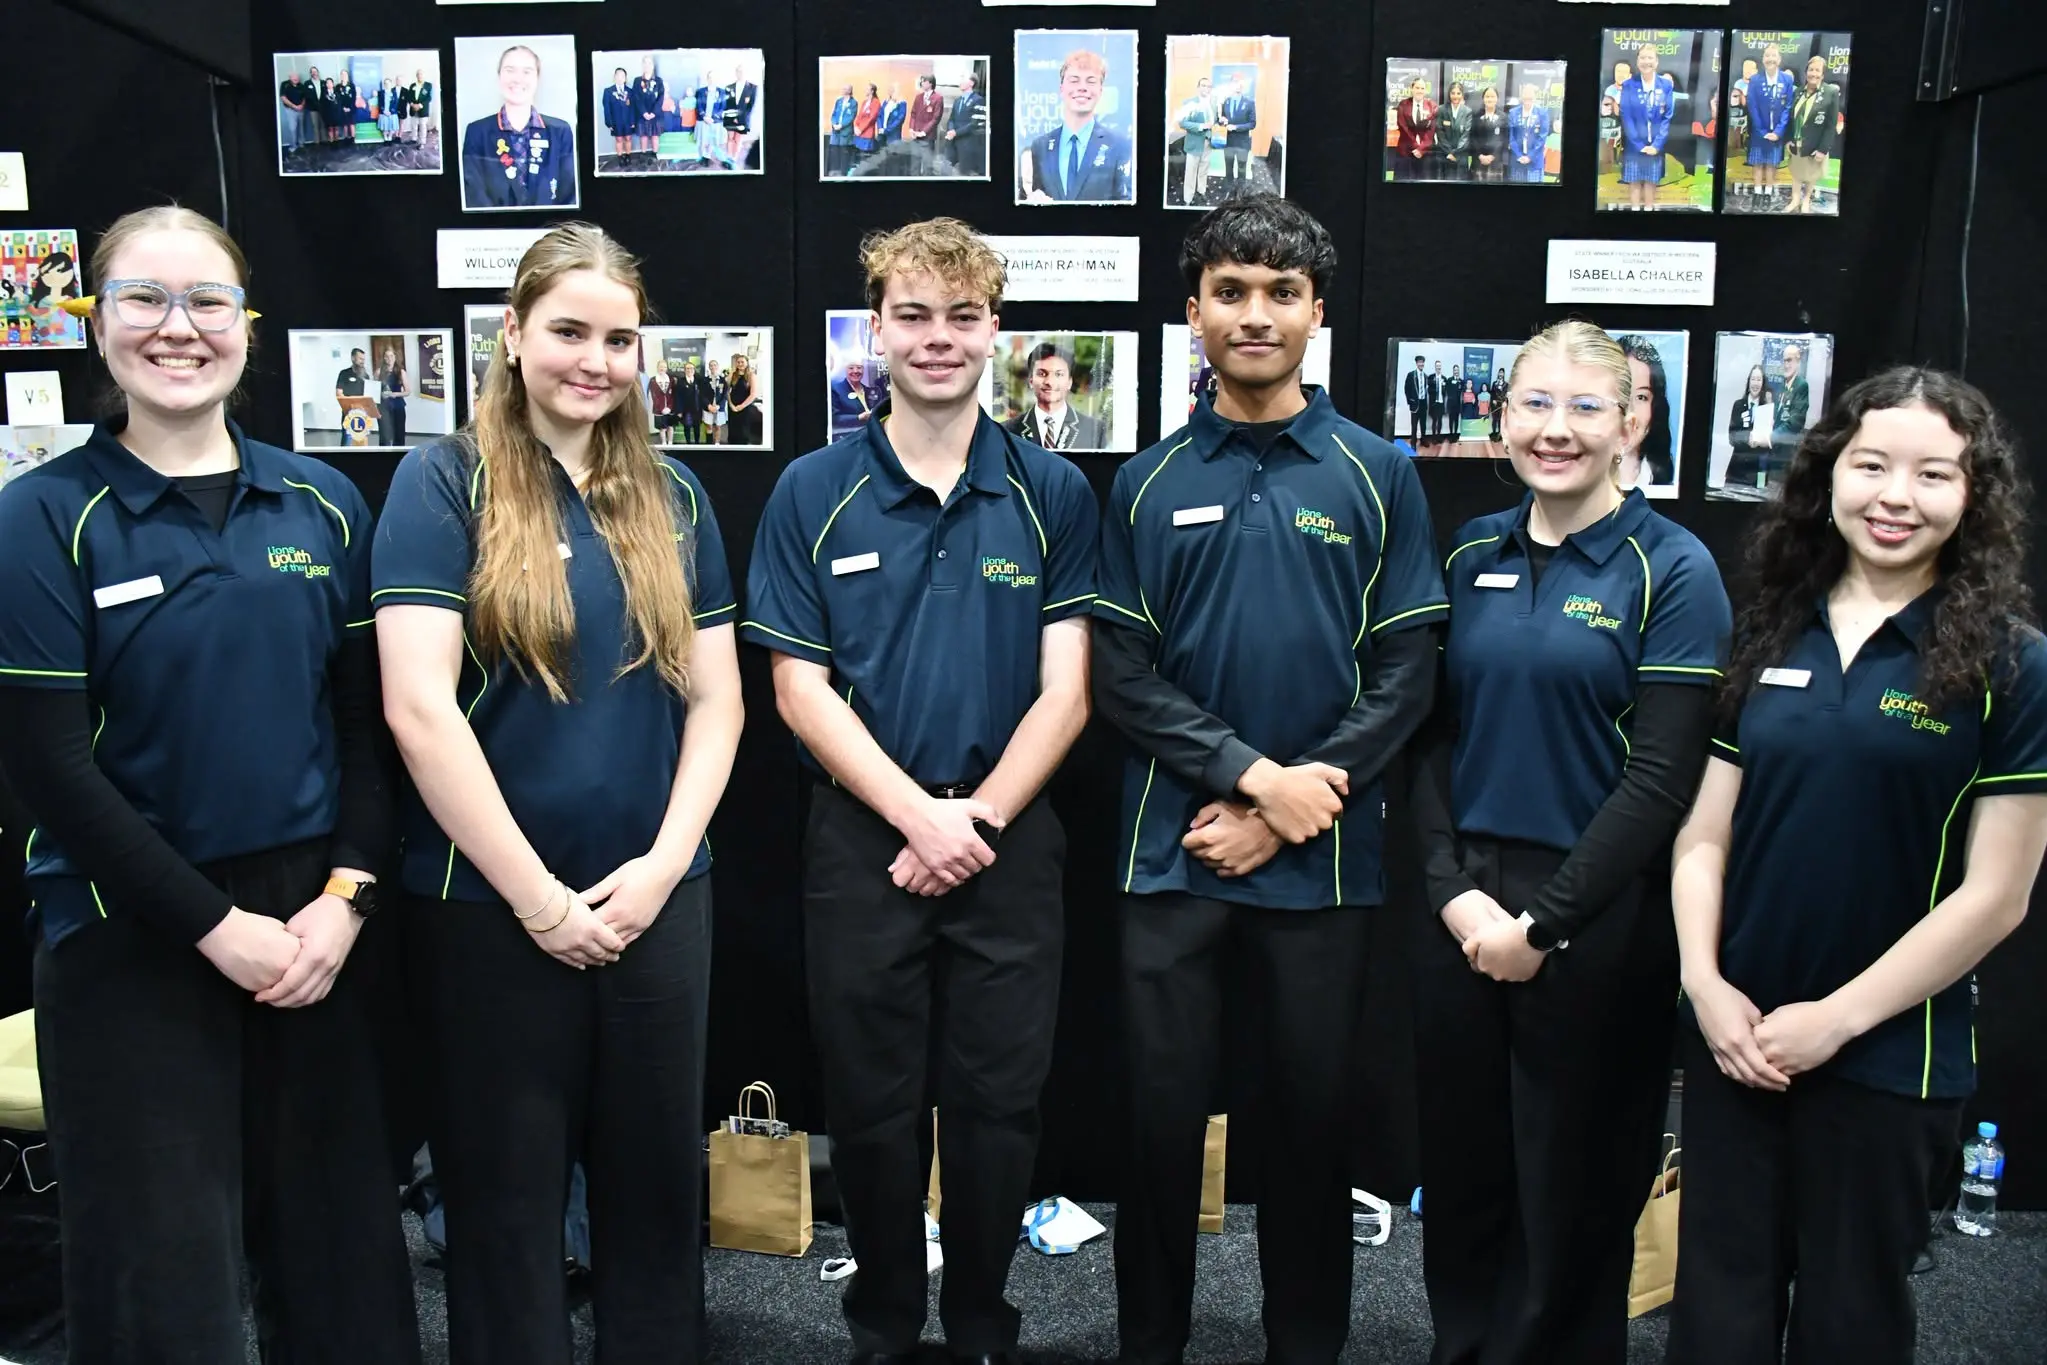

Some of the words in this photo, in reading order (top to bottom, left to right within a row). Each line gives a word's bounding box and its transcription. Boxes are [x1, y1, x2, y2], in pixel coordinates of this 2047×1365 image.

[1656, 44, 1680, 55] ear
[1779, 44, 1800, 54] ear
[1829, 46, 1850, 56] Lion
[465, 258, 518, 268] WILLOW
[1057, 260, 1116, 271] RAHMAN
[1569, 269, 1635, 281] ISABELLA
[1639, 270, 1704, 282] CHALKER
[1296, 507, 1322, 518] Lions
[1295, 515, 1335, 531] youth
[1301, 525, 1309, 533] of
[1311, 526, 1324, 536] the
[1323, 530, 1352, 545] year
[267, 546, 296, 555] Lions
[268, 549, 312, 568] youth
[982, 556, 1006, 565] Lions
[280, 563, 288, 572] of
[290, 563, 304, 572] the
[304, 565, 331, 578] year
[983, 561, 1019, 577] youth
[989, 573, 997, 582] of
[998, 573, 1010, 582] the
[1011, 575, 1037, 588] year
[1562, 601, 1602, 614] youth
[1587, 614, 1622, 630] year
[1879, 695, 1928, 715] youth
[1911, 714, 1951, 735] year
